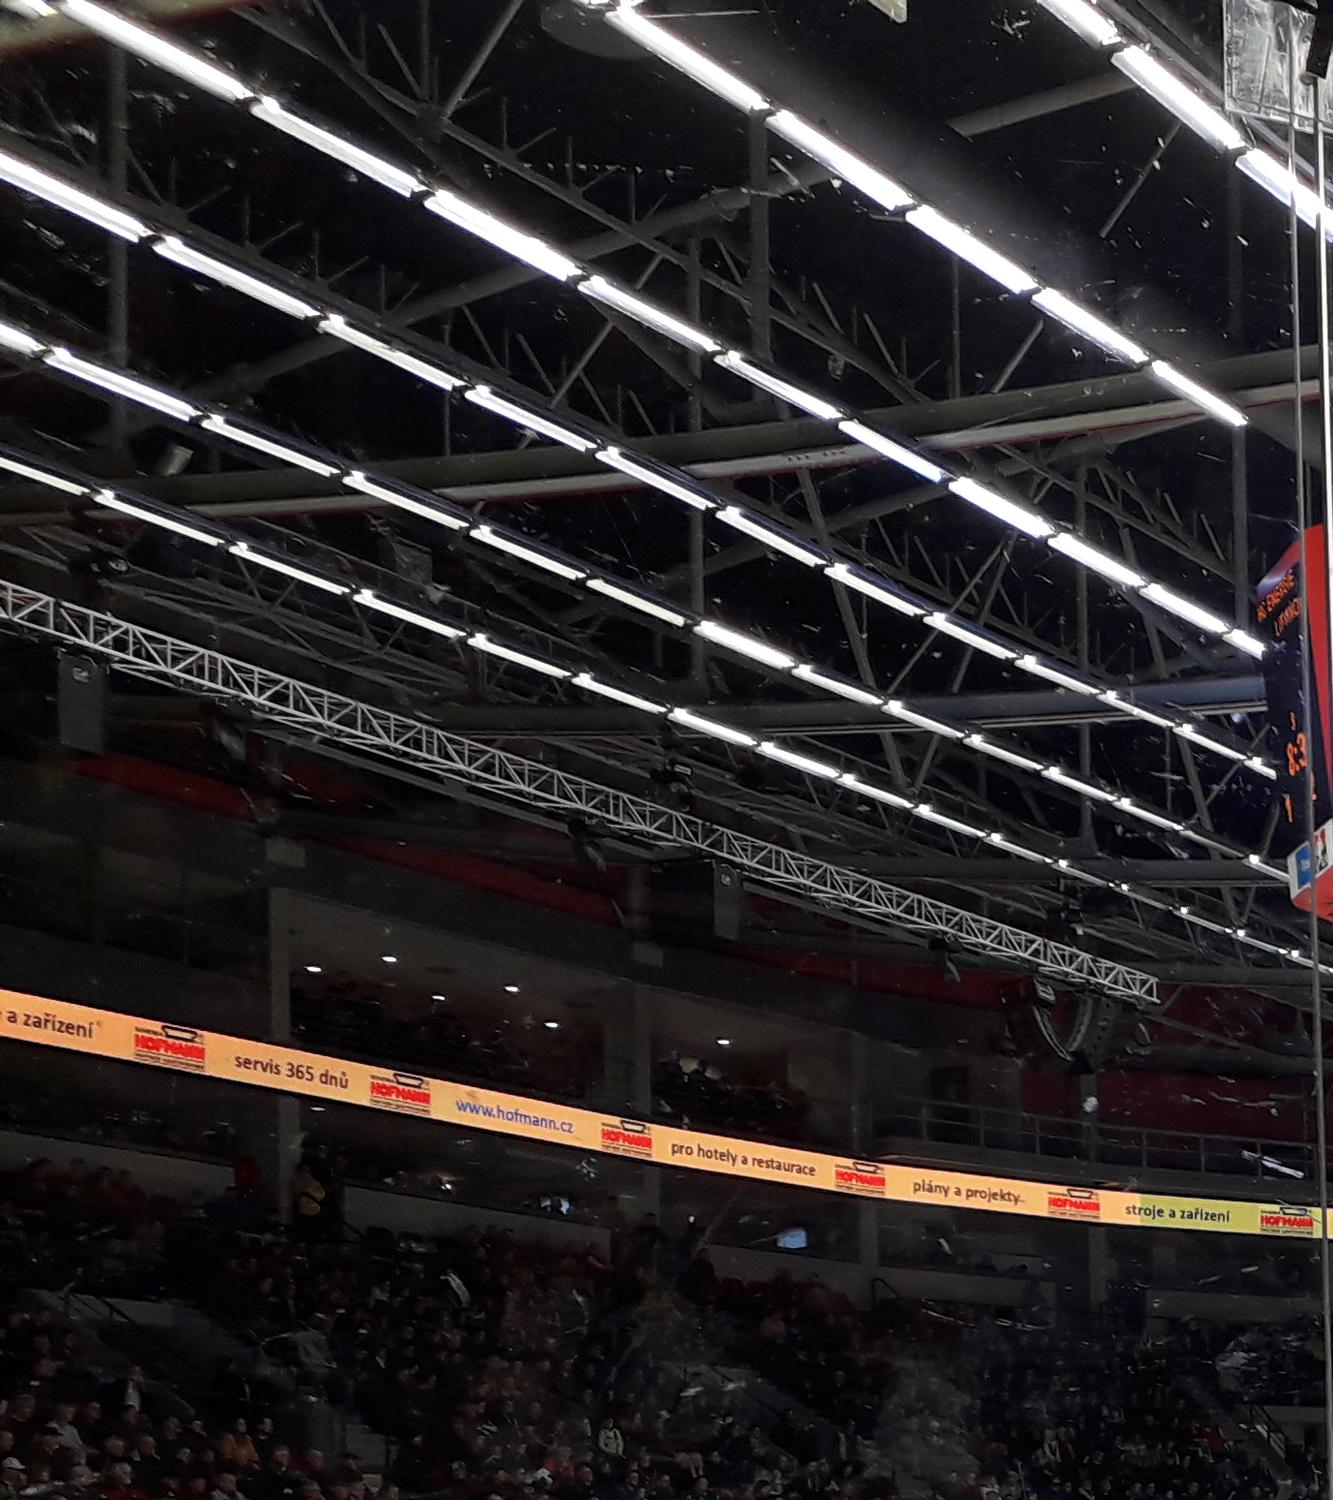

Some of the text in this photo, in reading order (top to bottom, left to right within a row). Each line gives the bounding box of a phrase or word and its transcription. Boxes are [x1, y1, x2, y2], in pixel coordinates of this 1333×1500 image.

[23, 1012, 95, 1040] zařízení
[234, 1053, 349, 1090] servis 365 dnů
[456, 1098, 575, 1135] www.hofmann.cz
[671, 1142, 817, 1177] pro hotely a restaurace
[913, 1178, 1021, 1206] plány a projekty
[1125, 1203, 1165, 1219] stroje
[1168, 1207, 1177, 1219] a
